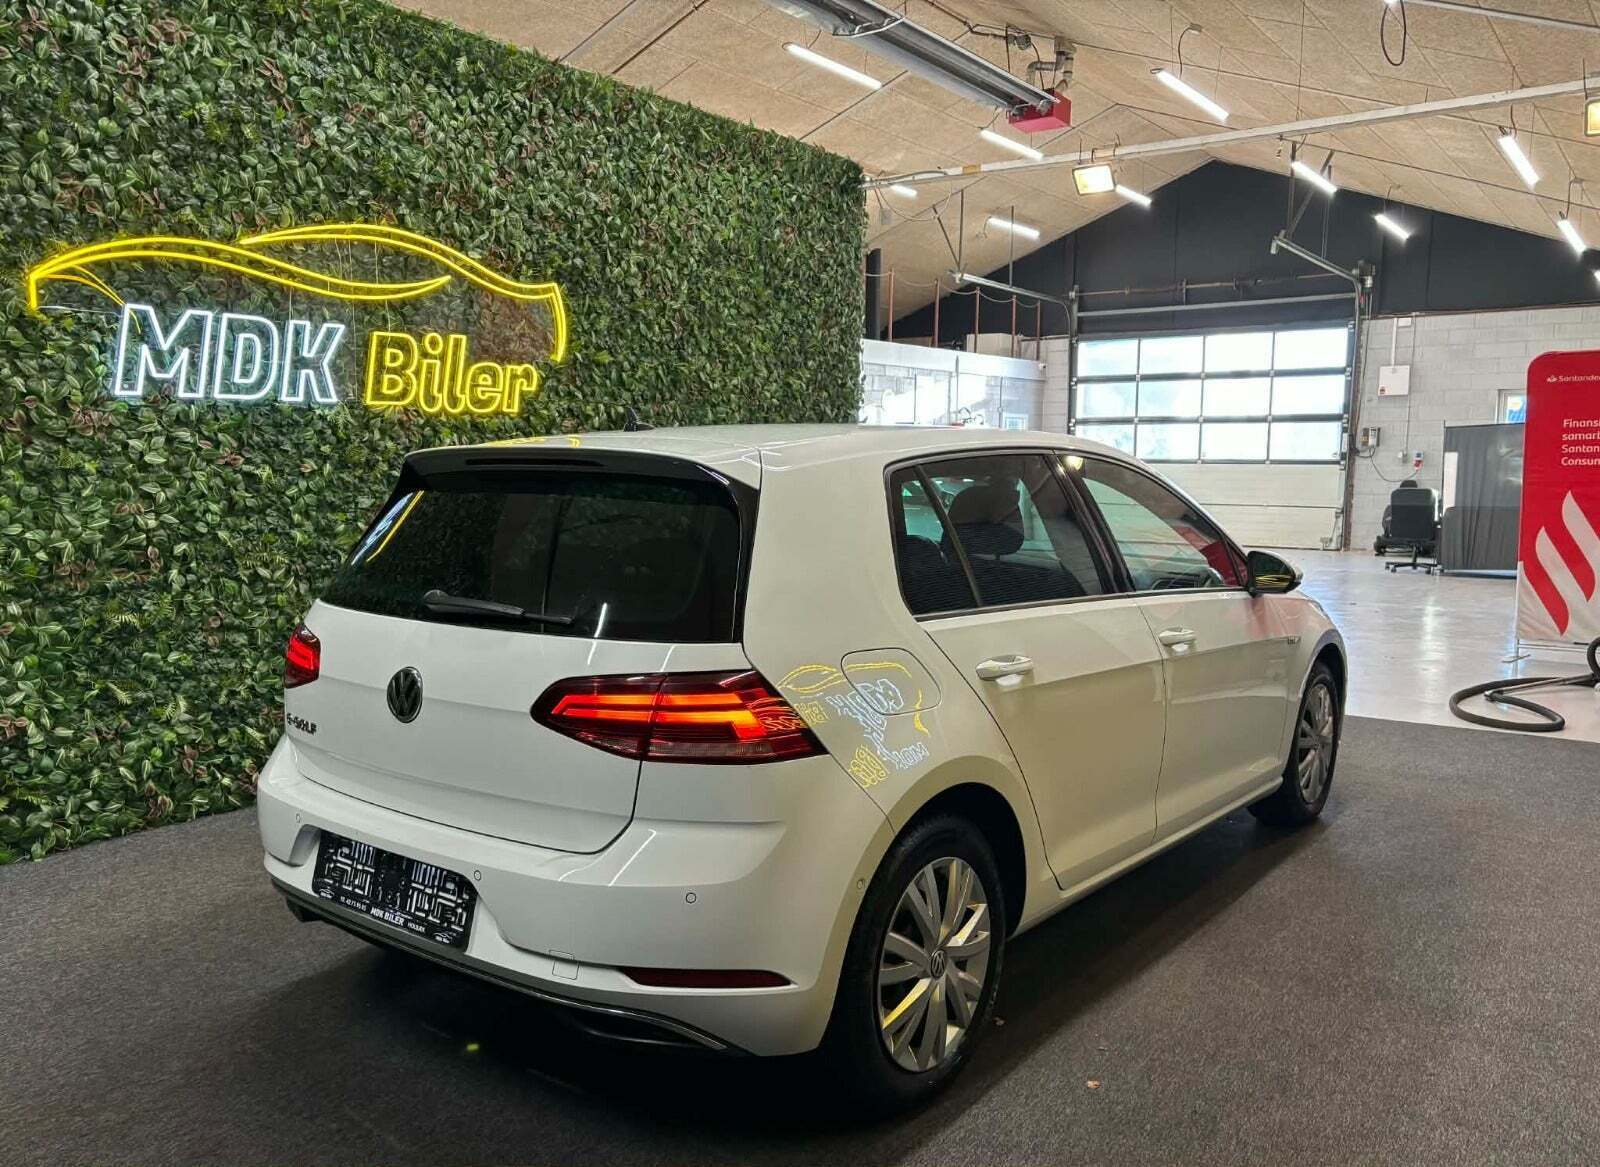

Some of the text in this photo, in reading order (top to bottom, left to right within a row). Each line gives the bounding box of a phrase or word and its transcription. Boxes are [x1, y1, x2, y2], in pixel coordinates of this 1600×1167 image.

[115, 302, 538, 413] MDK Biler
[383, 911, 405, 926] BILER
